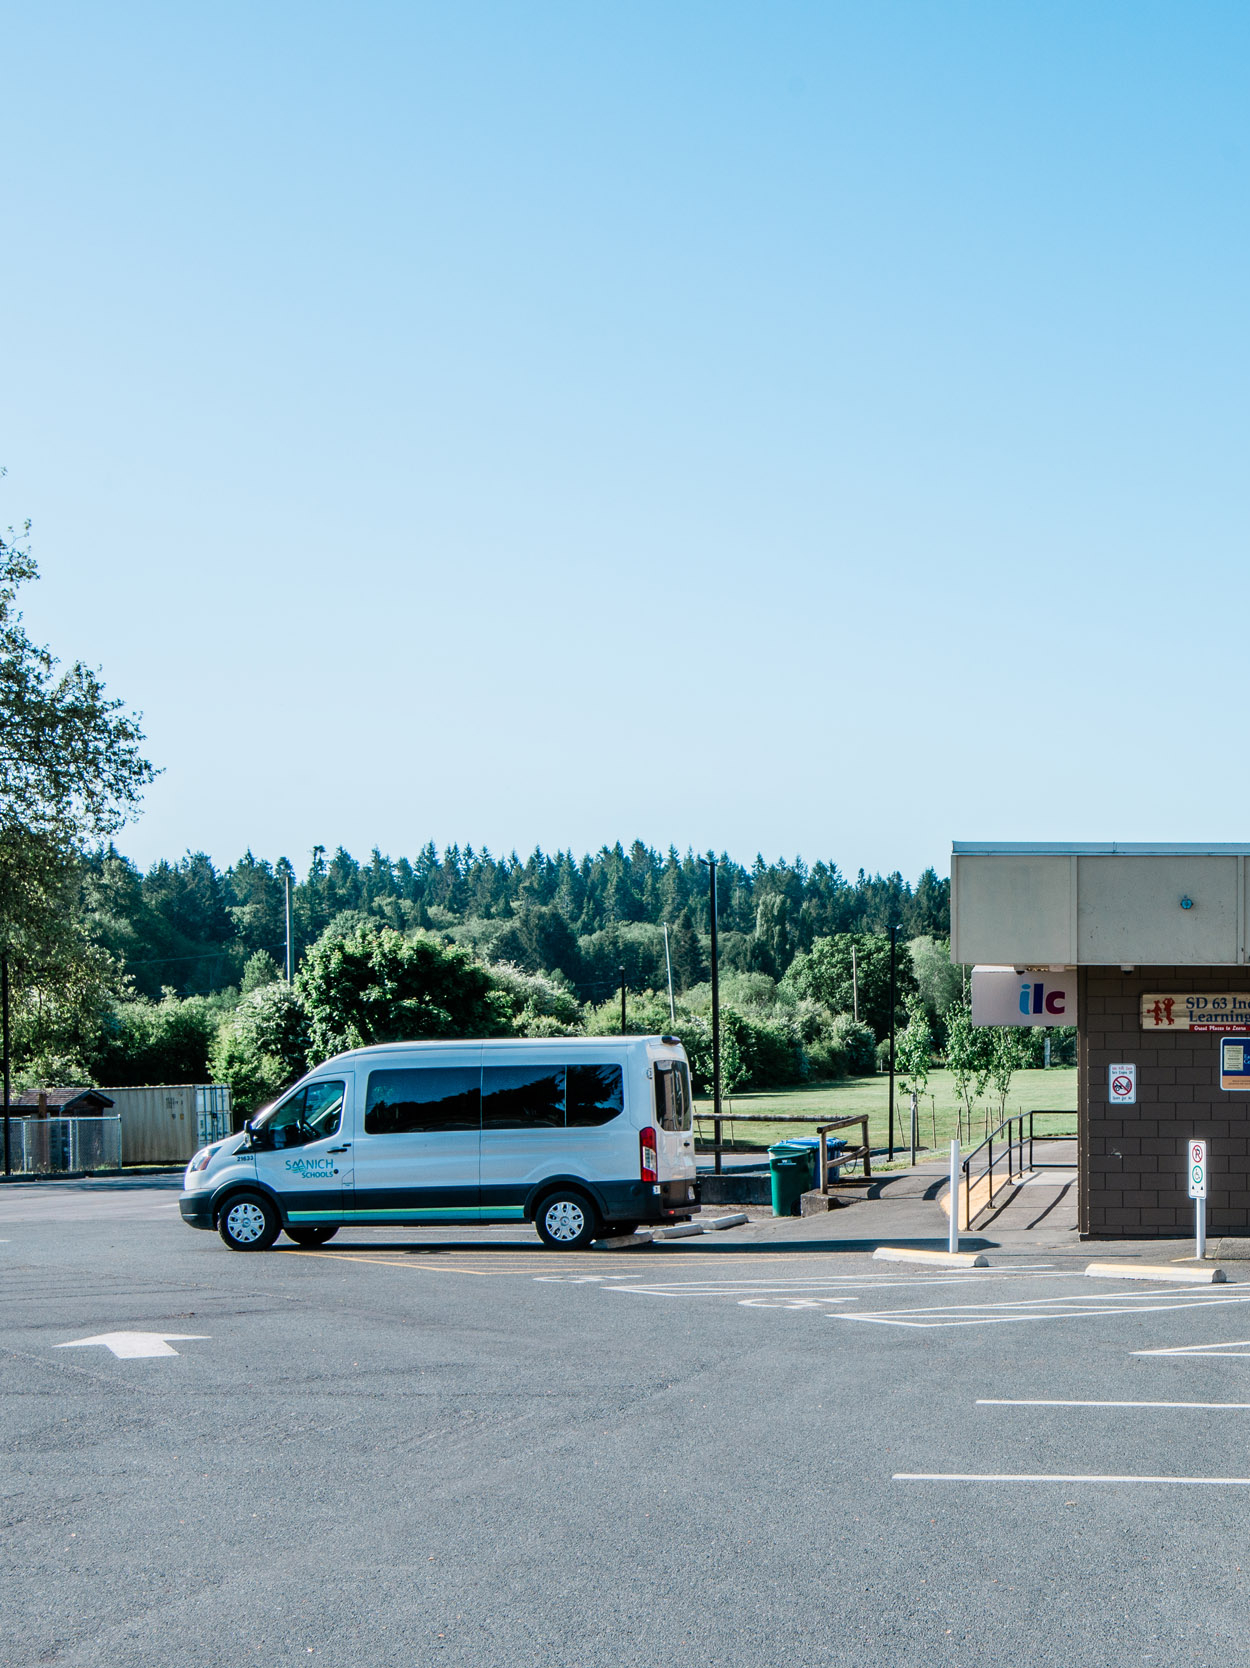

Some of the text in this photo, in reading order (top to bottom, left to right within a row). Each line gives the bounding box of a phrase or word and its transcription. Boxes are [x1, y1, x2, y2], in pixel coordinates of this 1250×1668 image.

[1019, 983, 1065, 1015] ilc
[1186, 997, 1208, 1009] SD
[1212, 997, 1228, 1009] 63
[285, 1158, 334, 1171] SAANICH
